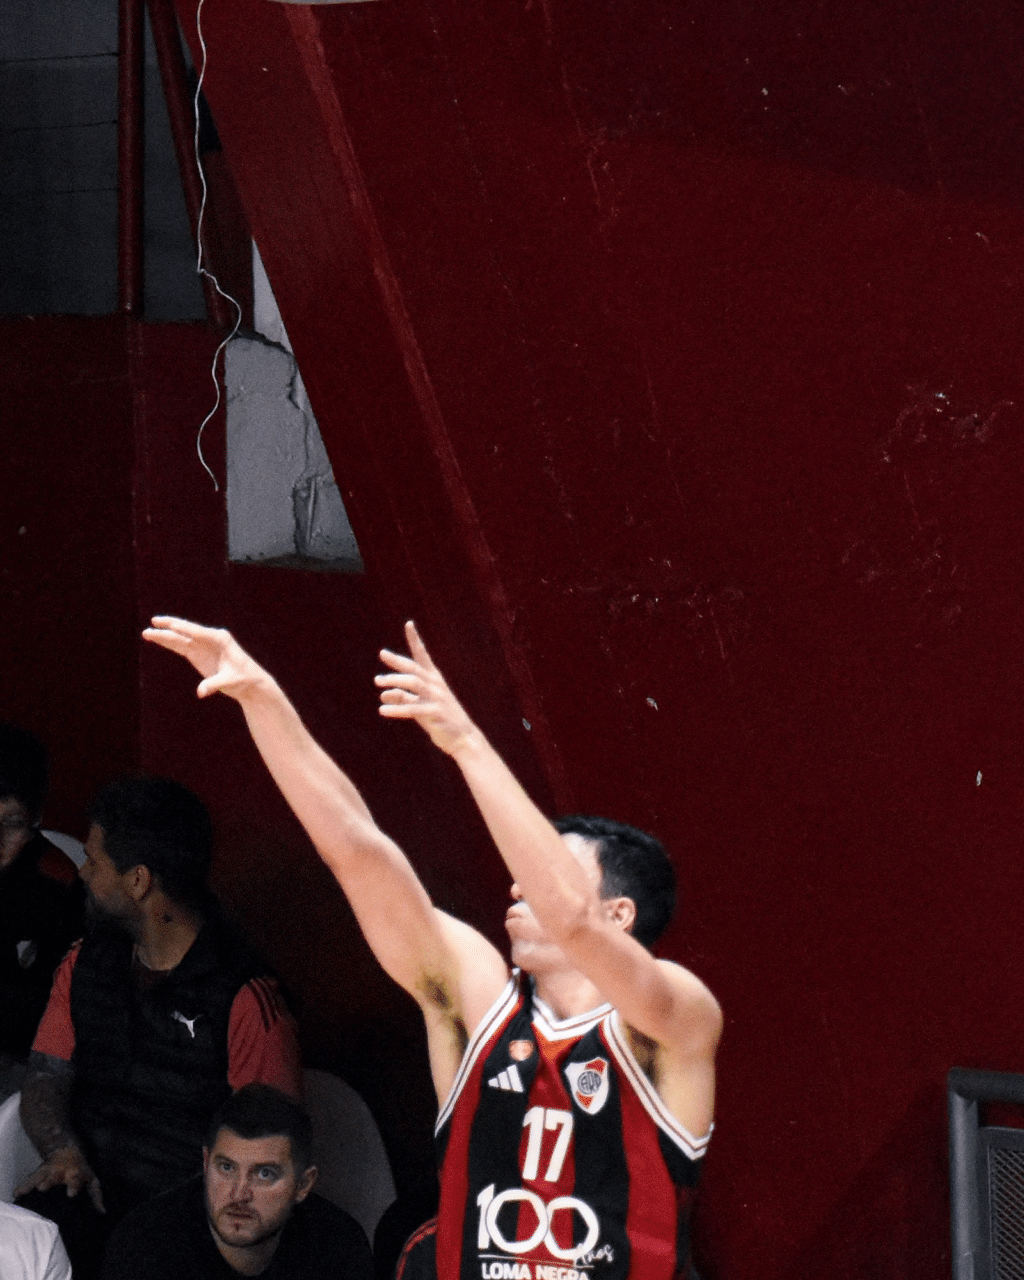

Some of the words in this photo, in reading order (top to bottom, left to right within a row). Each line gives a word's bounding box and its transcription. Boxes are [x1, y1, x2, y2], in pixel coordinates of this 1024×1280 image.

[522, 1105, 575, 1183] 17
[476, 1183, 600, 1261] 100
[481, 1262, 533, 1280] LOMA
